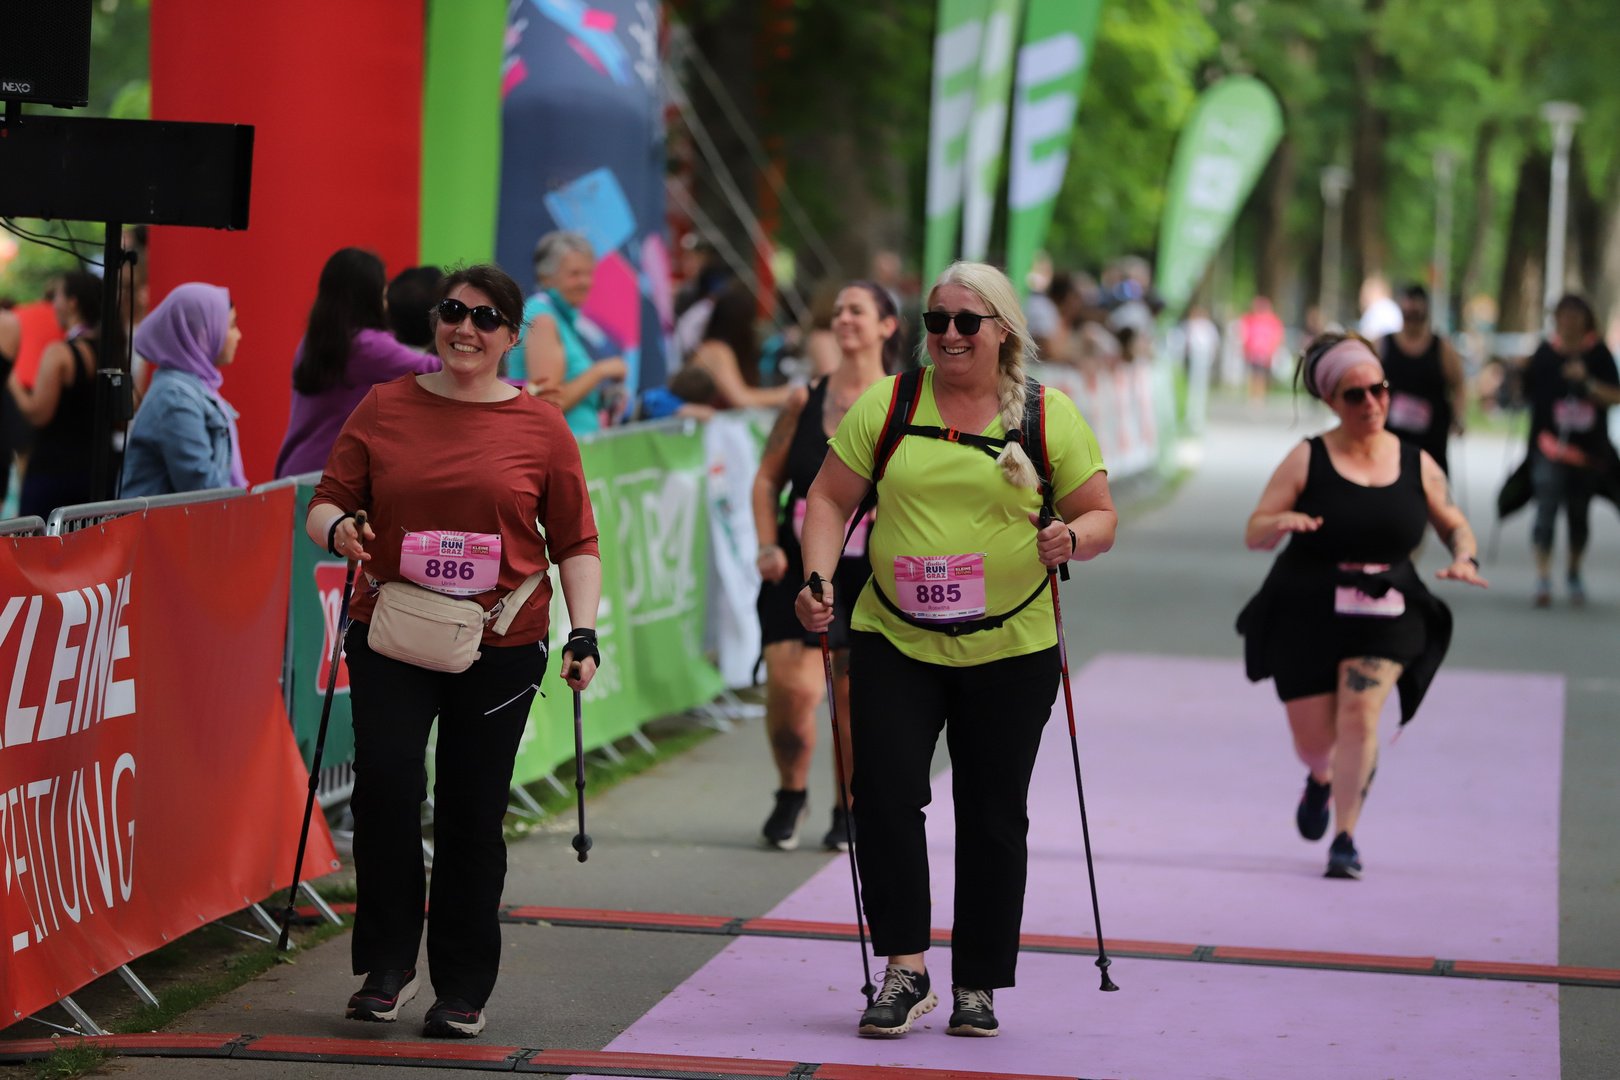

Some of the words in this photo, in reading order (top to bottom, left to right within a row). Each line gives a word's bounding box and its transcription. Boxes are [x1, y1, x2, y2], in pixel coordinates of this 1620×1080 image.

[2, 82, 31, 93] NEXO
[441, 541, 463, 549] RUN
[425, 559, 475, 580] 886
[916, 584, 961, 604] 885
